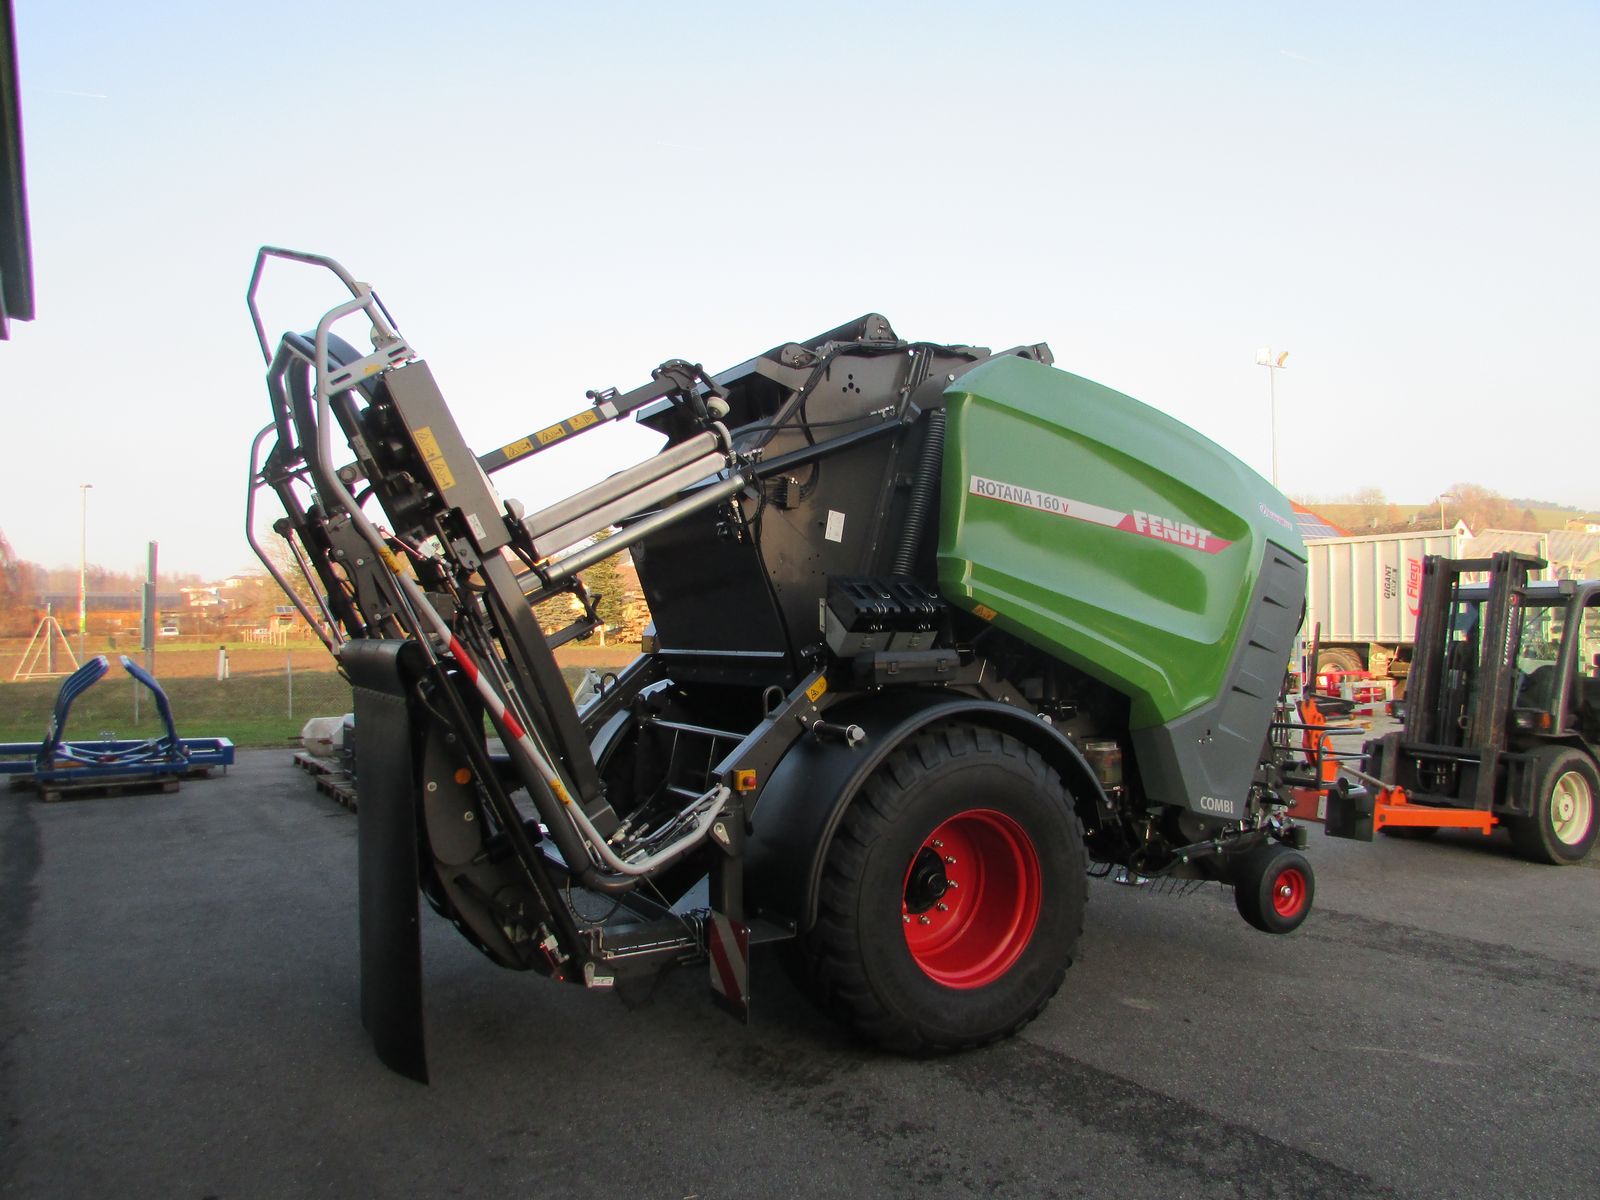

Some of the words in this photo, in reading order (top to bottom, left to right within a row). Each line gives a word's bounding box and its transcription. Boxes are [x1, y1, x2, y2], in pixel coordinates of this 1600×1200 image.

[976, 479, 1032, 505] ROTANA
[1036, 494, 1060, 511] 160
[1132, 509, 1211, 549] FENDT
[1384, 564, 1392, 600] GIGANT
[1407, 558, 1420, 599] Fliegl
[1200, 796, 1233, 814] COMBI
